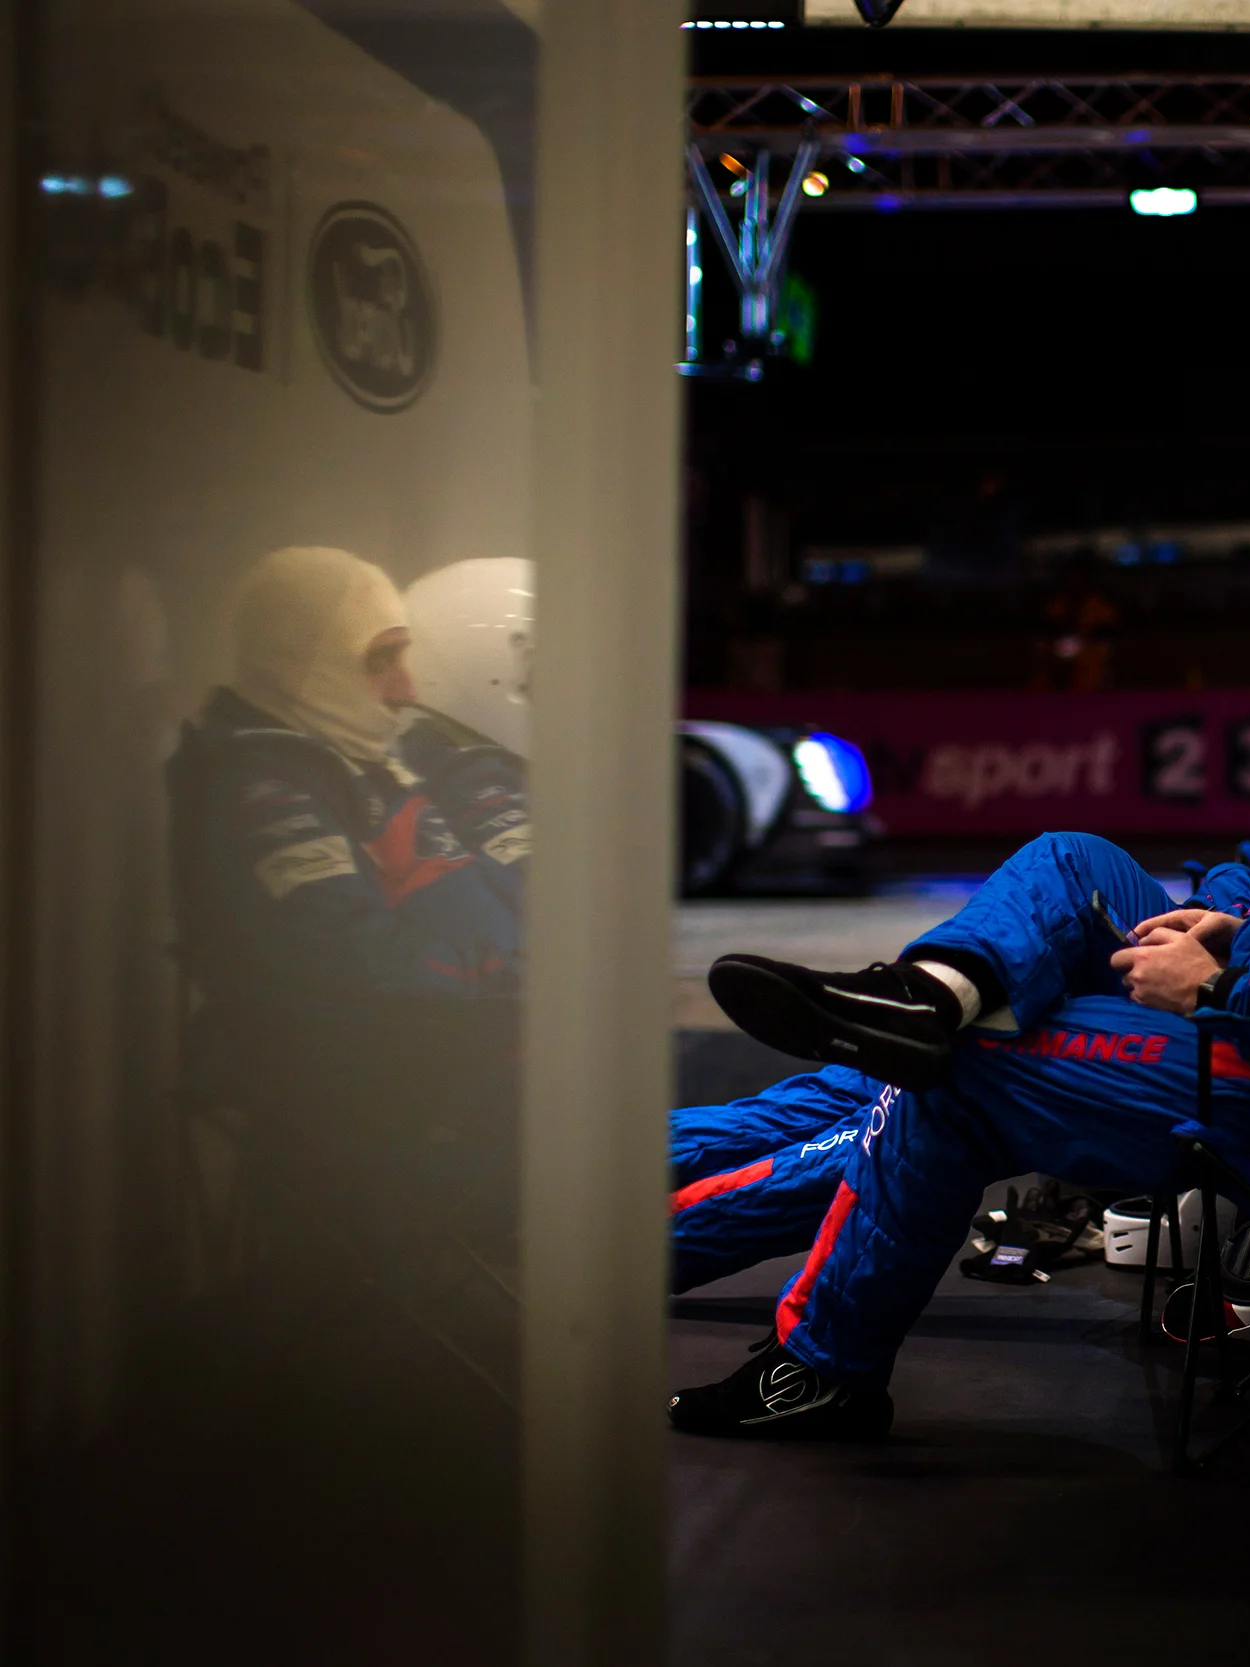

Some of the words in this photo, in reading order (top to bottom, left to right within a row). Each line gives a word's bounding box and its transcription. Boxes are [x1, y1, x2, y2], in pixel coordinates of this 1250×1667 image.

[1152, 729, 1205, 793] 2
[977, 1029, 1170, 1064] MANCE
[862, 1084, 901, 1158] FOR
